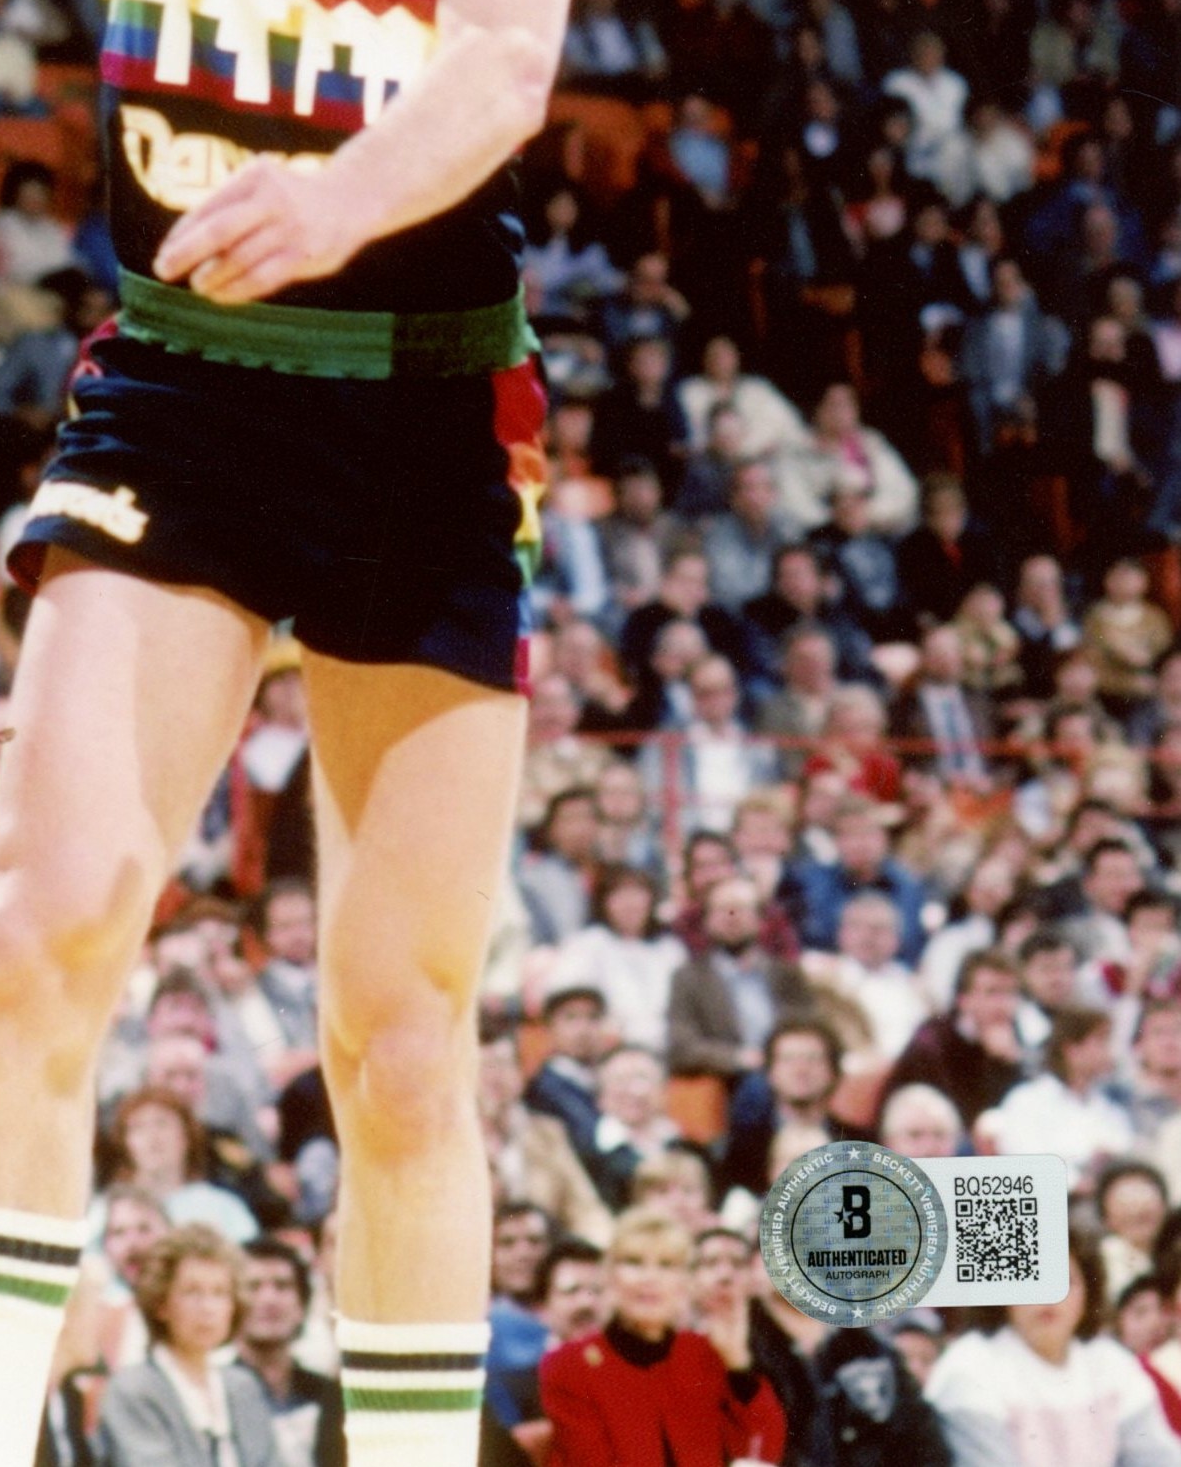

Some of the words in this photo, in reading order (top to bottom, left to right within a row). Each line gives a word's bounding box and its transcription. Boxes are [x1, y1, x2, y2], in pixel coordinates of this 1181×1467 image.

[778, 1152, 835, 1211] AUTHENTIC
[872, 1152, 925, 1192] BECKETT
[953, 1175, 1034, 1197] BQ52946
[920, 1193, 938, 1255] VERIFIED
[772, 1214, 790, 1275] VERIFIED
[807, 1249, 907, 1268] AUTHENTICATED
[825, 1269, 891, 1281] AUTOGRAPH
[876, 1257, 934, 1315] AUTHENTIC
[785, 1276, 837, 1315] BECKETT
